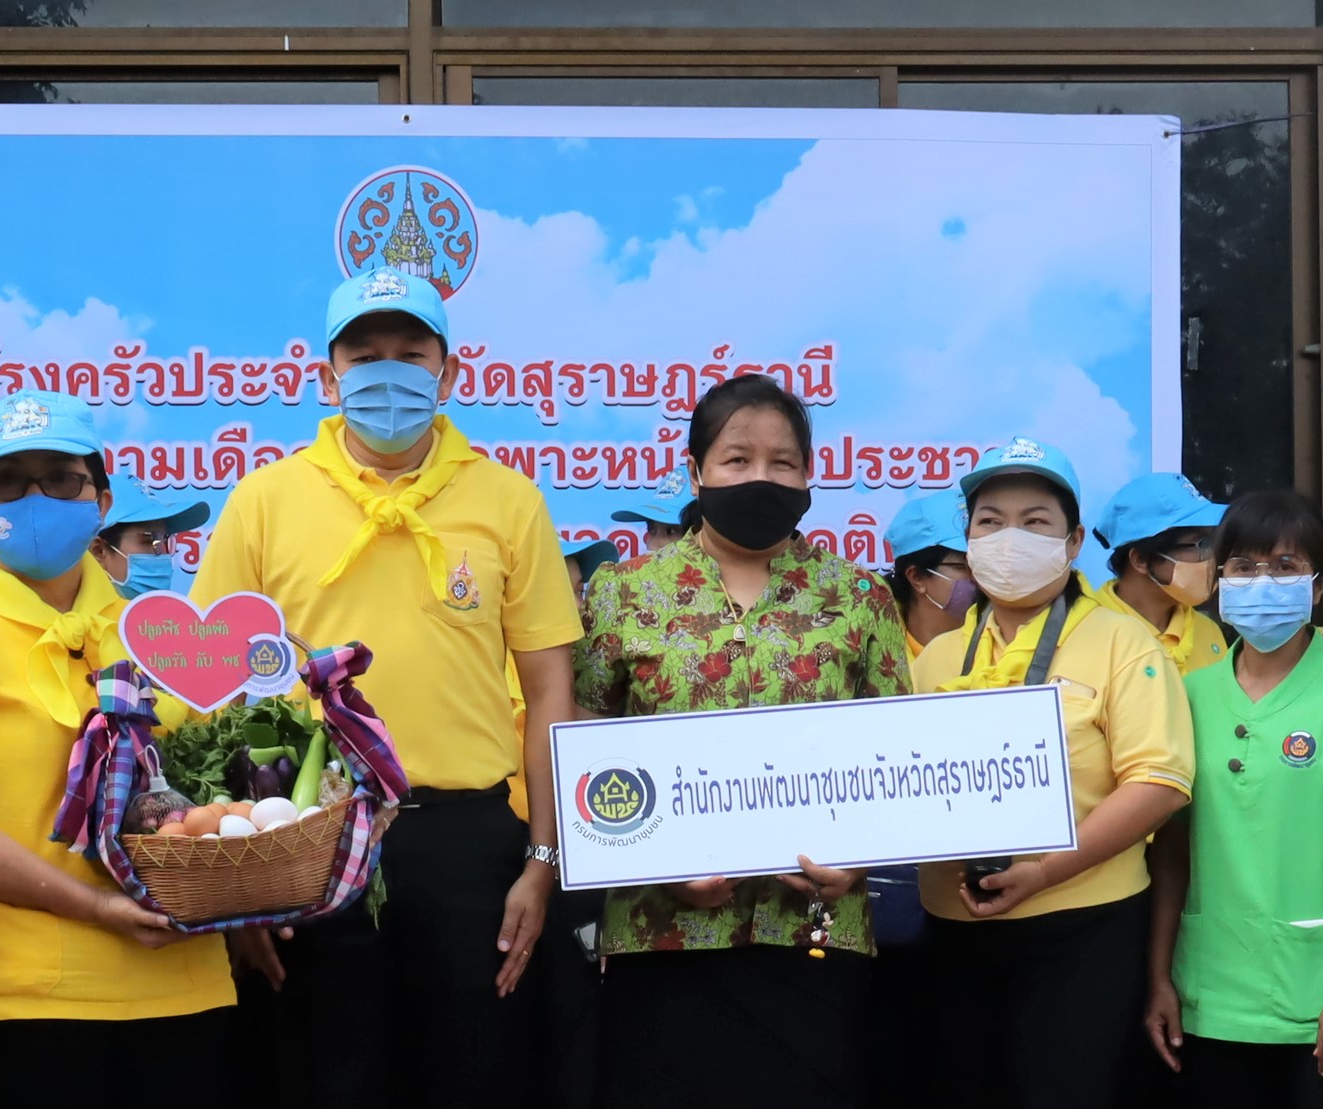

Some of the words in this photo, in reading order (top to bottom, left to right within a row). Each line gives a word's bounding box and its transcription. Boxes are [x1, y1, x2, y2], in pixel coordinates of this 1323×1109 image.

[137, 619, 180, 641] ปลูกพืช
[188, 619, 229, 641] ปลูกผัก
[147, 651, 188, 672] ปลูกรัก
[196, 651, 213, 668] กับ
[221, 655, 241, 668] พช
[670, 737, 1052, 822] สำนักงานพัฒนาชุมชนจังหวัดสุราษฎร์ธานี
[572, 814, 664, 848] กรมการพัฒนาชุมชน
